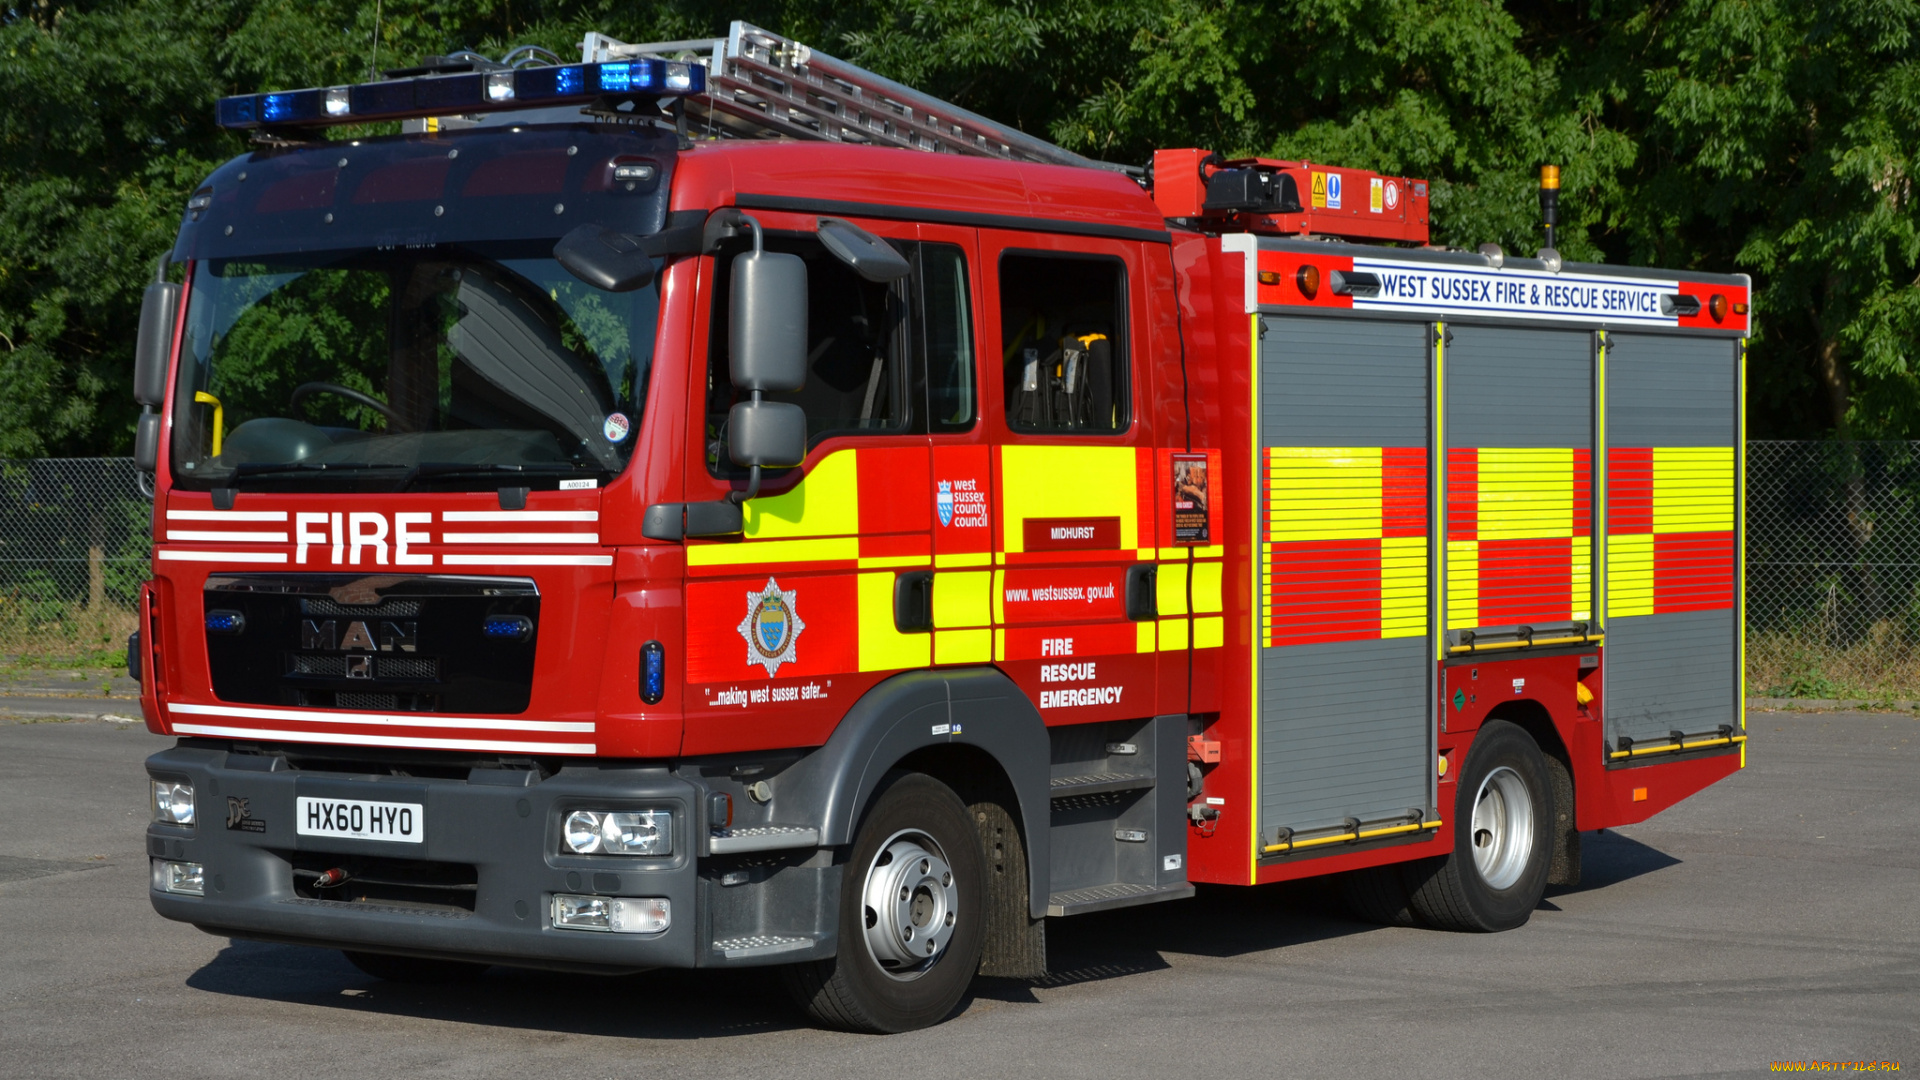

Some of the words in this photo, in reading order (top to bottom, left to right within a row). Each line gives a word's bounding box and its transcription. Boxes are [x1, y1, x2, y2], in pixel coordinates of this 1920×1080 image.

[1382, 273, 1427, 298] WEST
[1431, 277, 1491, 302] SUSSEX
[1496, 281, 1526, 304] FIRE
[1530, 284, 1540, 305] &
[1545, 285, 1598, 309] RESCUE
[1602, 289, 1657, 312] SERVICE
[954, 478, 976, 491] west
[954, 492, 985, 502] sussex
[954, 502, 987, 517] county
[954, 513, 988, 527] council
[296, 512, 433, 565] FIRE
[1051, 526, 1095, 539] MIDHURST
[1006, 589, 1030, 602] www.
[1032, 585, 1086, 601] westsussex.
[1087, 582, 1115, 604] gov.uk
[302, 620, 417, 652] MAN
[1042, 638, 1073, 656] FIRE
[1041, 662, 1096, 682] RESCUE
[750, 685, 769, 703] west
[772, 686, 799, 702] sussex
[1040, 686, 1123, 708] EMERGENCY
[308, 802, 363, 832] HX60
